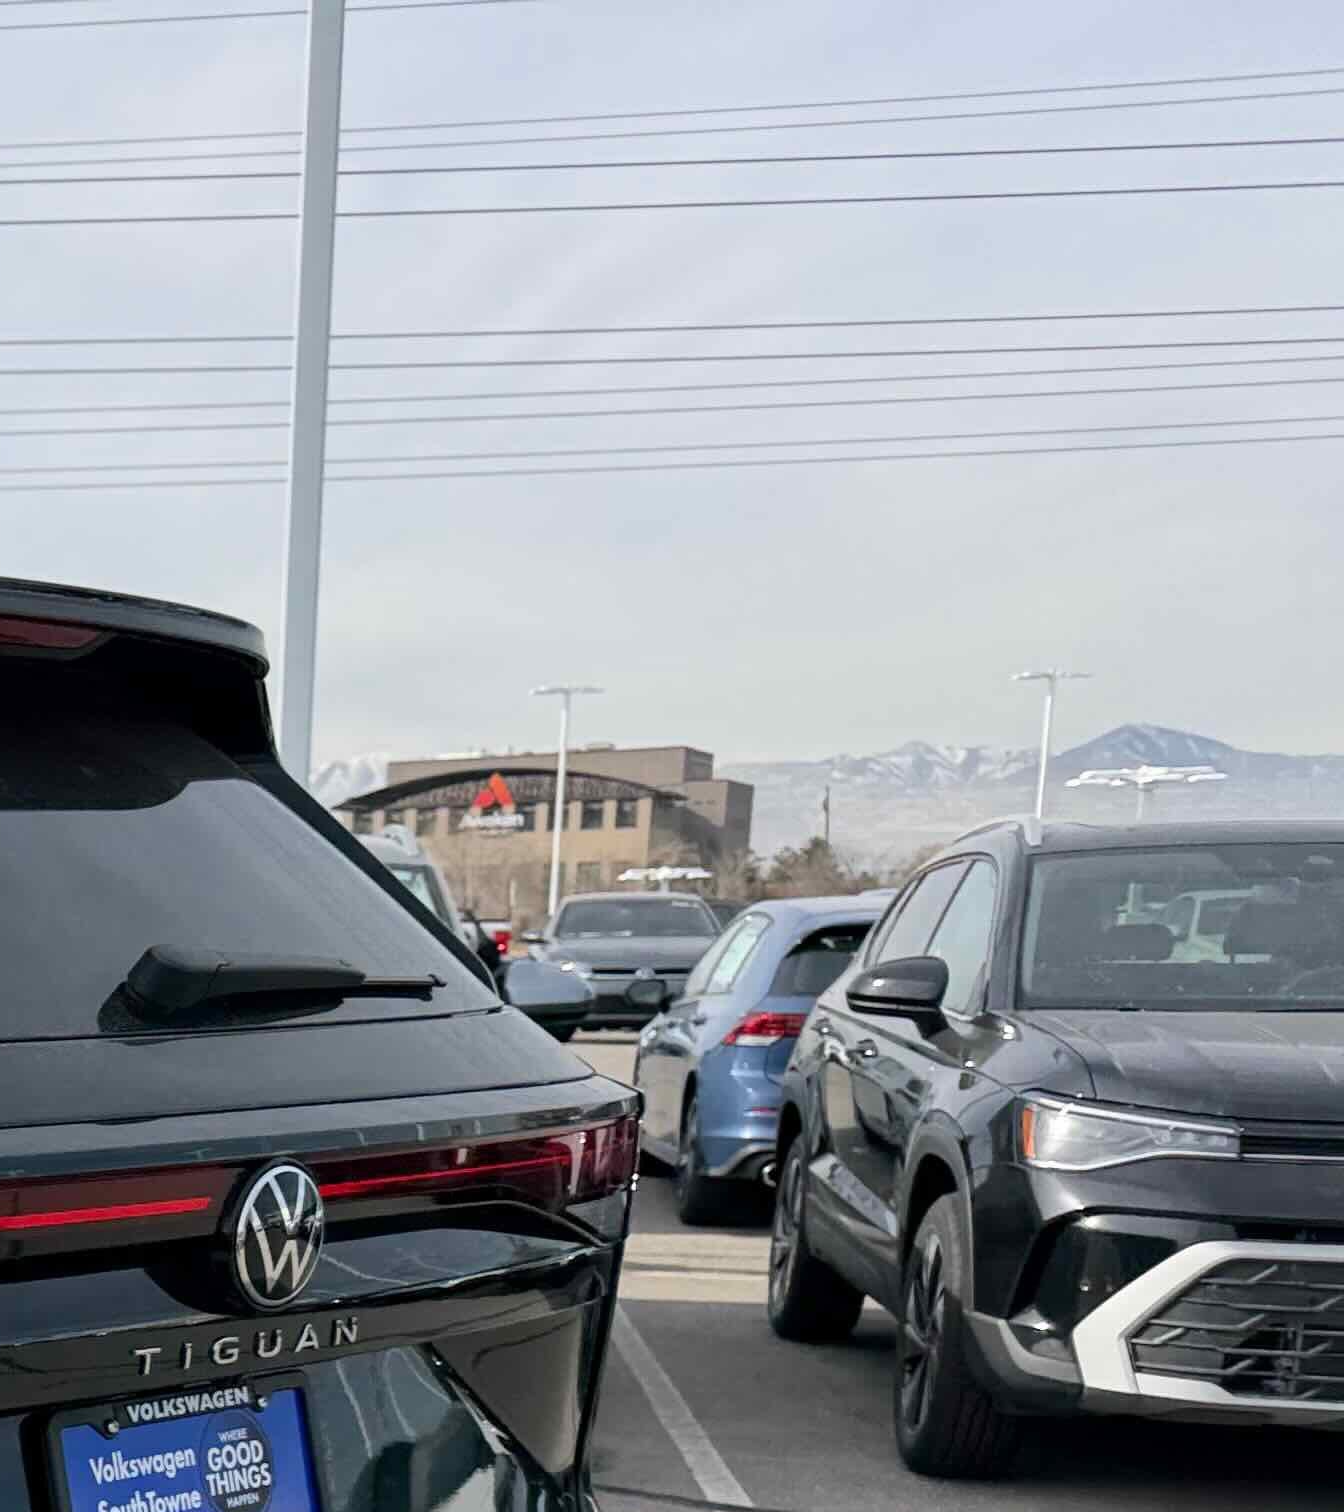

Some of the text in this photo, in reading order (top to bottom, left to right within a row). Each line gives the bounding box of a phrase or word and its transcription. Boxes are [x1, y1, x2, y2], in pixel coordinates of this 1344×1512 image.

[134, 1316, 359, 1376] TIGUAN
[126, 1385, 249, 1424] VOLKSWAGEN
[217, 1427, 248, 1443] WHERE
[89, 1447, 196, 1485] Volkswagen
[207, 1439, 264, 1472] GOOD
[205, 1463, 272, 1497] THINGS
[226, 1493, 260, 1509] HAPPEN
